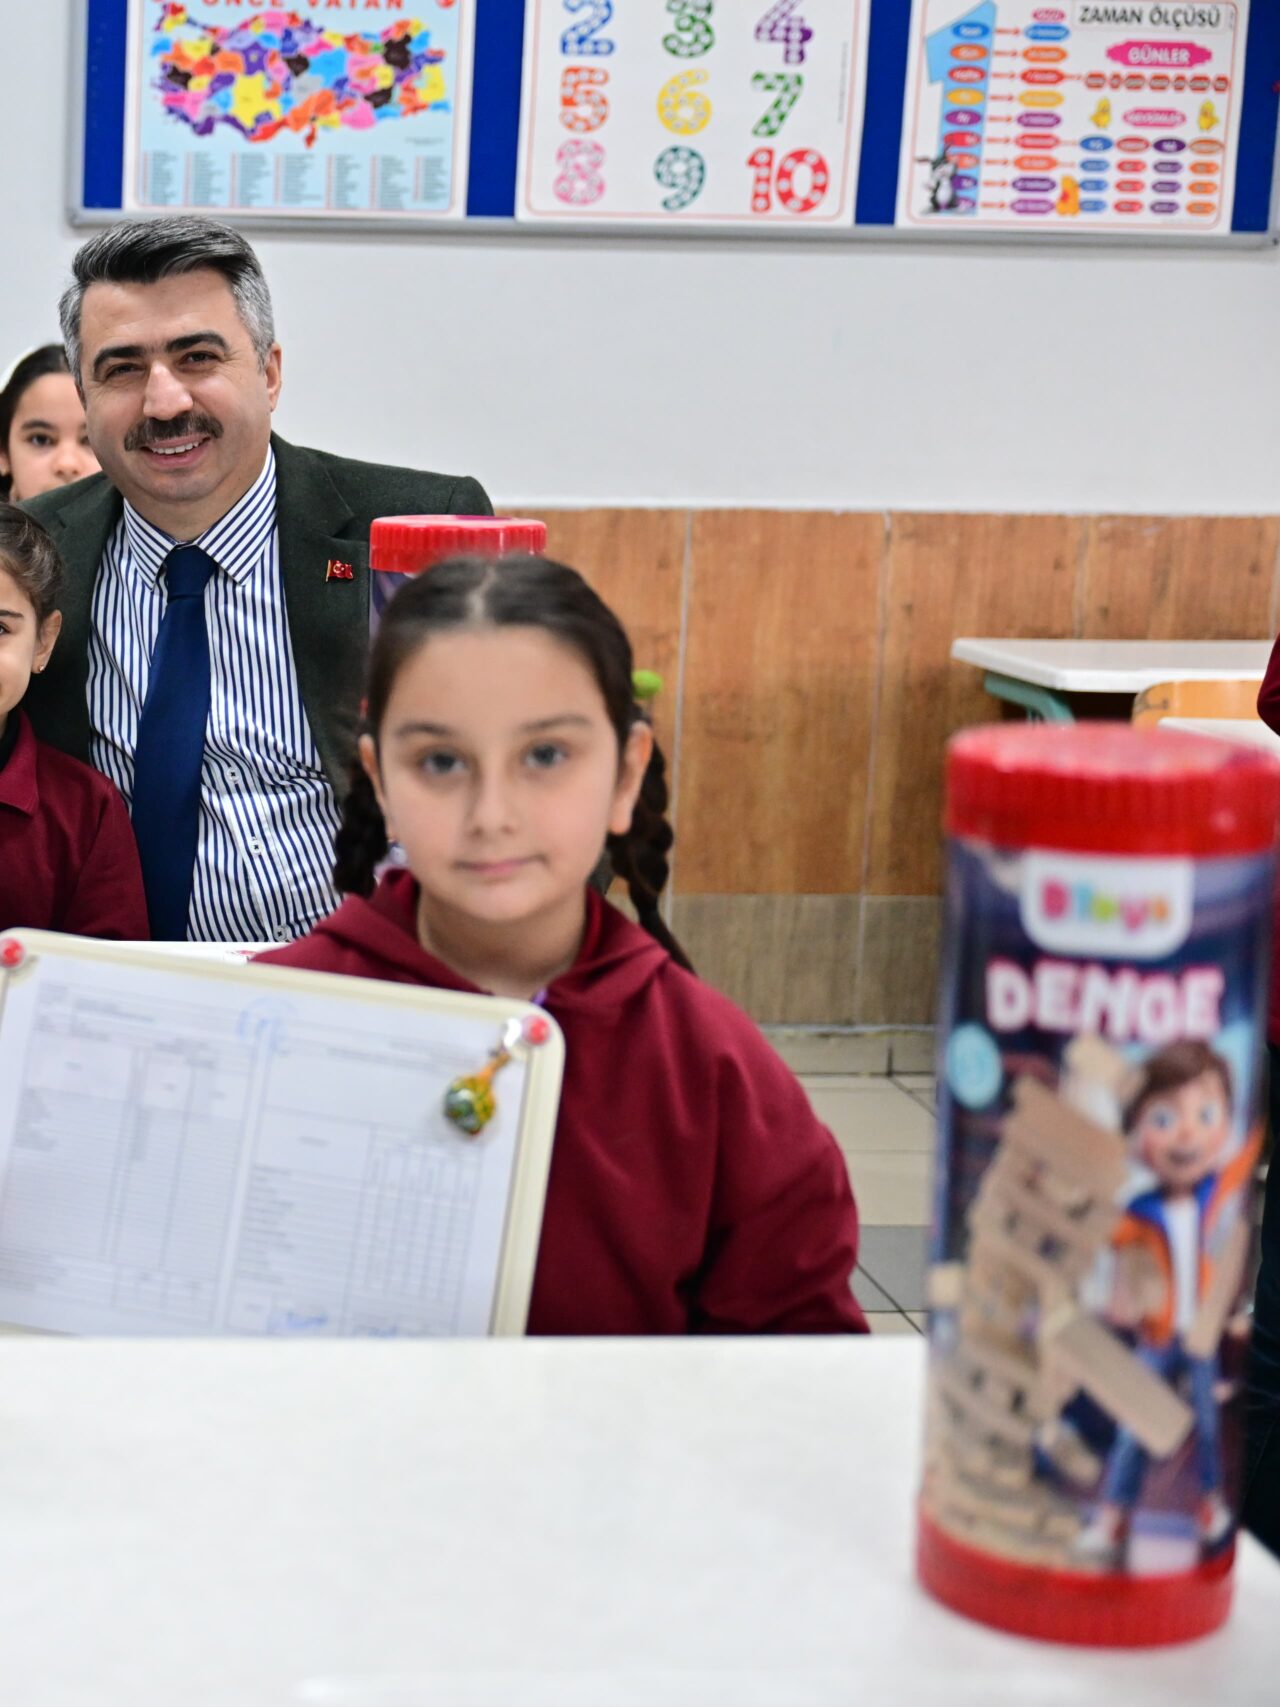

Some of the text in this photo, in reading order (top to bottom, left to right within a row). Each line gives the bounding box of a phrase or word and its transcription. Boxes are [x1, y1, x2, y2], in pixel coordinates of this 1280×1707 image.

[561, 0, 813, 64] 2 3 4
[1079, 5, 1143, 25] ZAMAN
[1149, 4, 1221, 31] ÖLÇÜSÜ
[1128, 45, 1192, 64] GÜNLER
[560, 66, 609, 132] 5
[656, 69, 712, 135] 6
[751, 71, 803, 137] 7
[553, 138, 829, 213] 8 9 10
